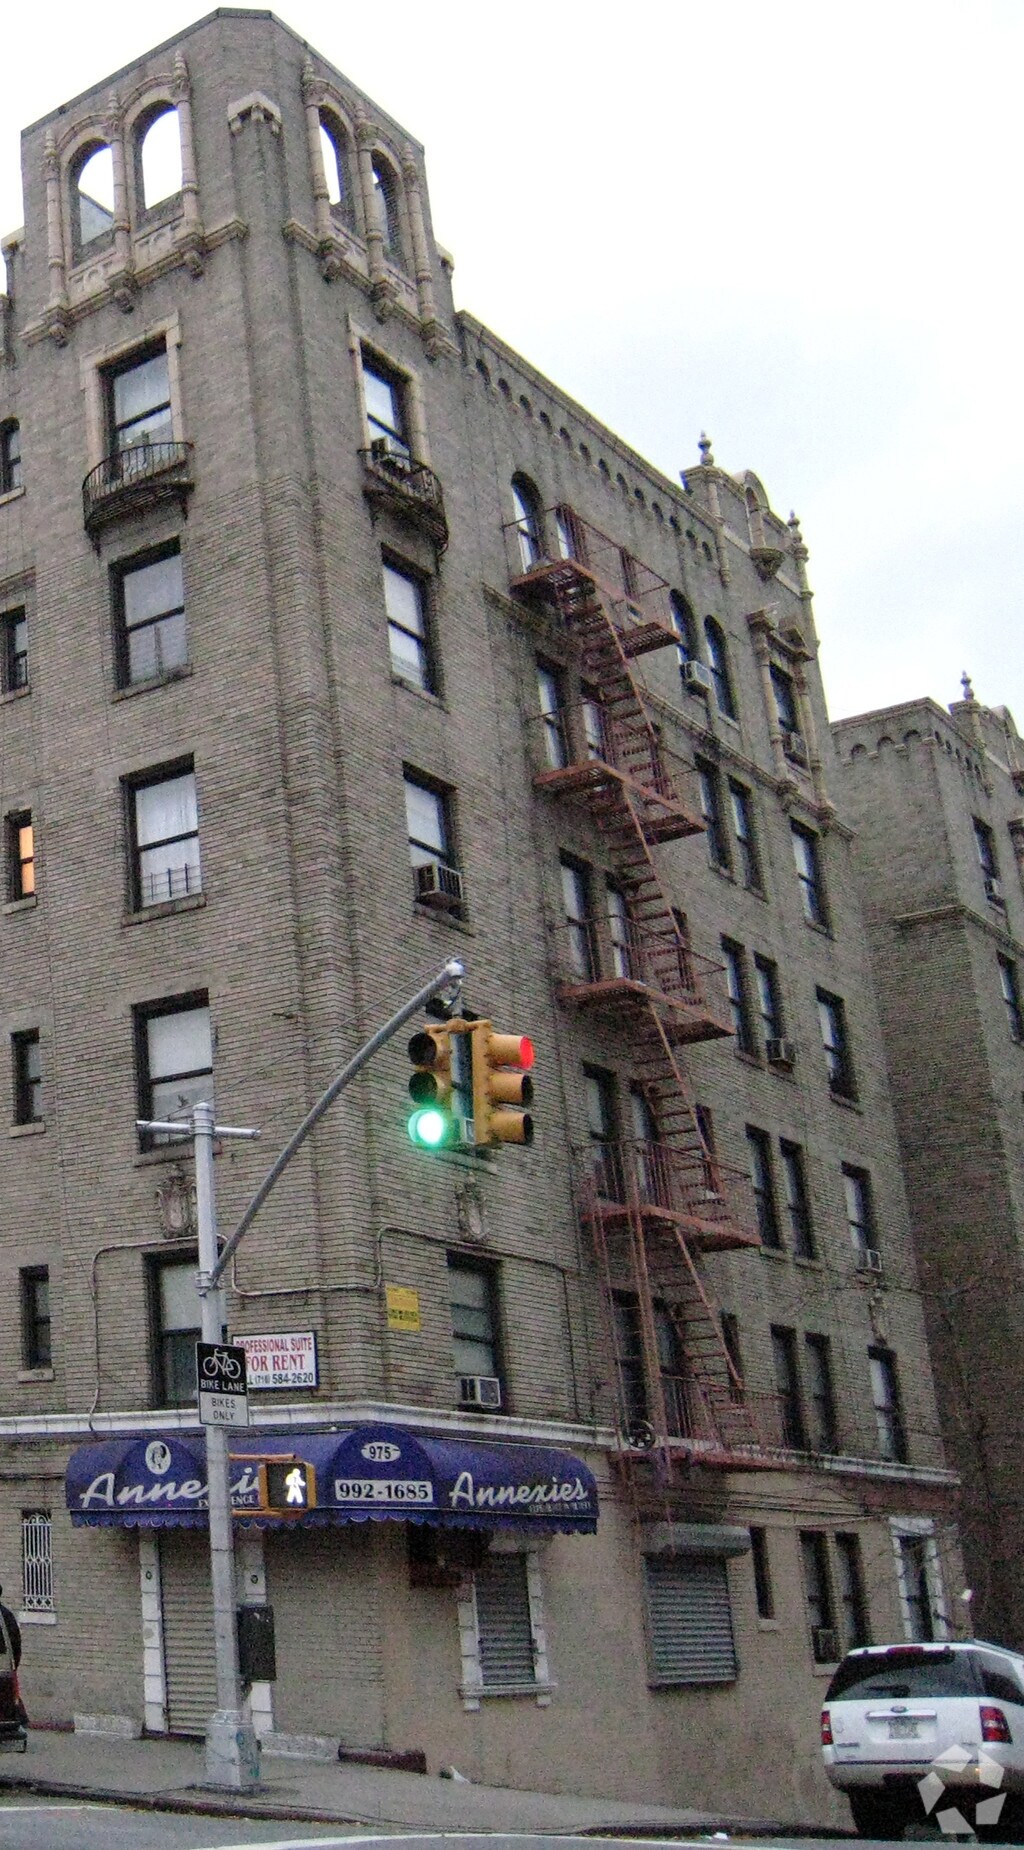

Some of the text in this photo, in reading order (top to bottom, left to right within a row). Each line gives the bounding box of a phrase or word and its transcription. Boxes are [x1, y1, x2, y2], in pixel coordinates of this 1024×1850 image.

[291, 1337, 312, 1351] SUITE
[246, 1354, 305, 1372] FOR RENT
[272, 1372, 314, 1384] 584-2620
[200, 1379, 245, 1392] BIKE LANE
[211, 1397, 236, 1409] BIKES
[213, 1411, 235, 1420] ONLY
[368, 1445, 392, 1459] 975
[339, 1482, 429, 1499] 992-1685
[449, 1472, 588, 1507] Annexies
